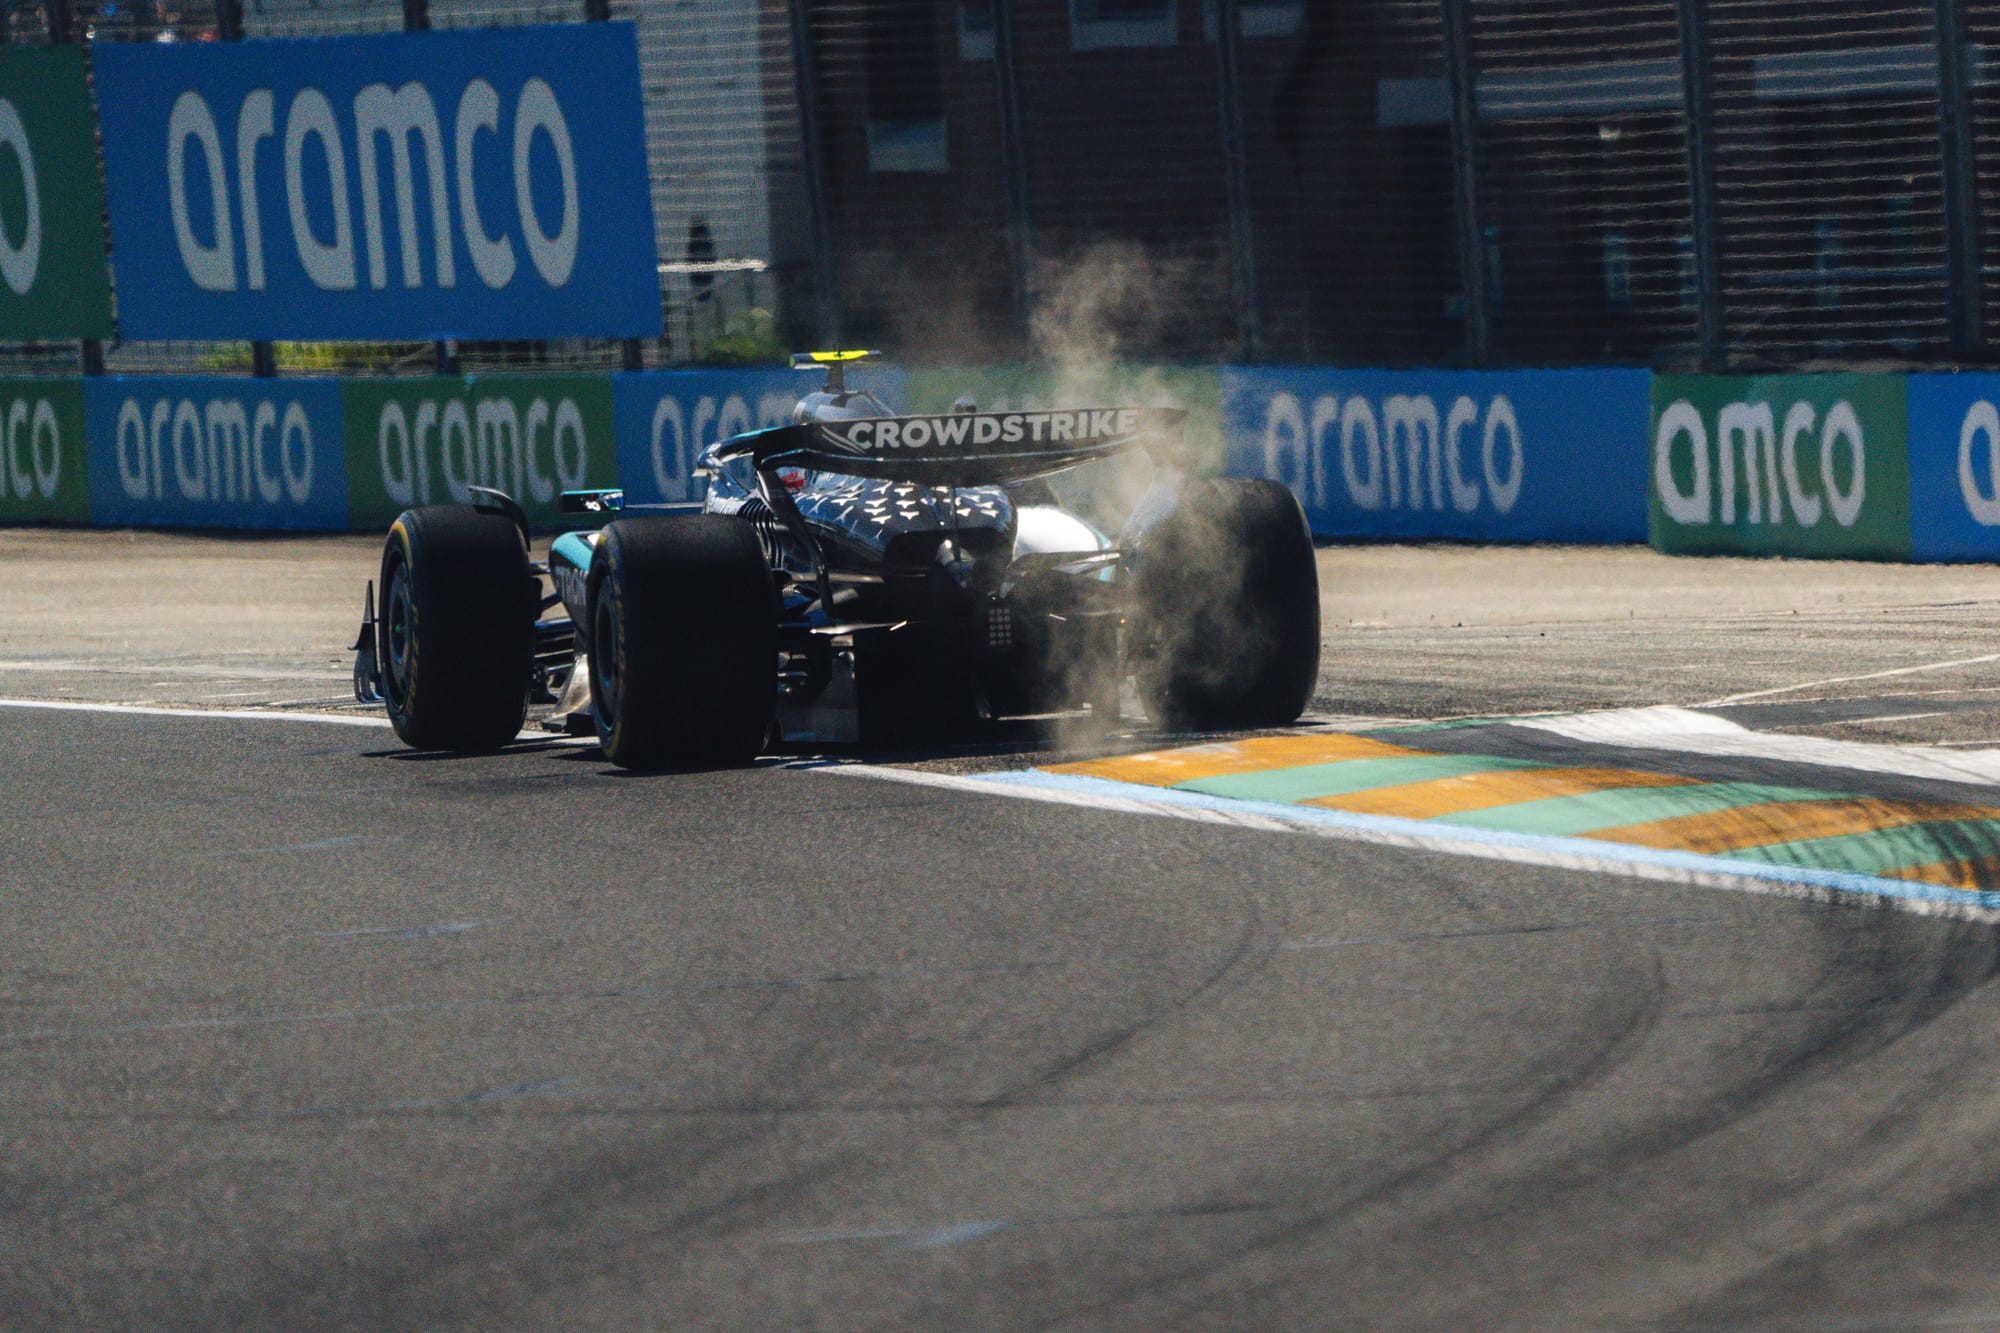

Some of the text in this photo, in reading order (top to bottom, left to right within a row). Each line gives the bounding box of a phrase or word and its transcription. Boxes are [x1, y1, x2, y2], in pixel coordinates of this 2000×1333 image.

[166, 77, 579, 291] aramco
[0, 398, 61, 501] co
[117, 397, 314, 504] aramco
[379, 397, 587, 505] aramco
[848, 408, 1139, 449] CROWDSTRIKE
[1265, 394, 1524, 512] aramco
[1655, 401, 1865, 527] amco
